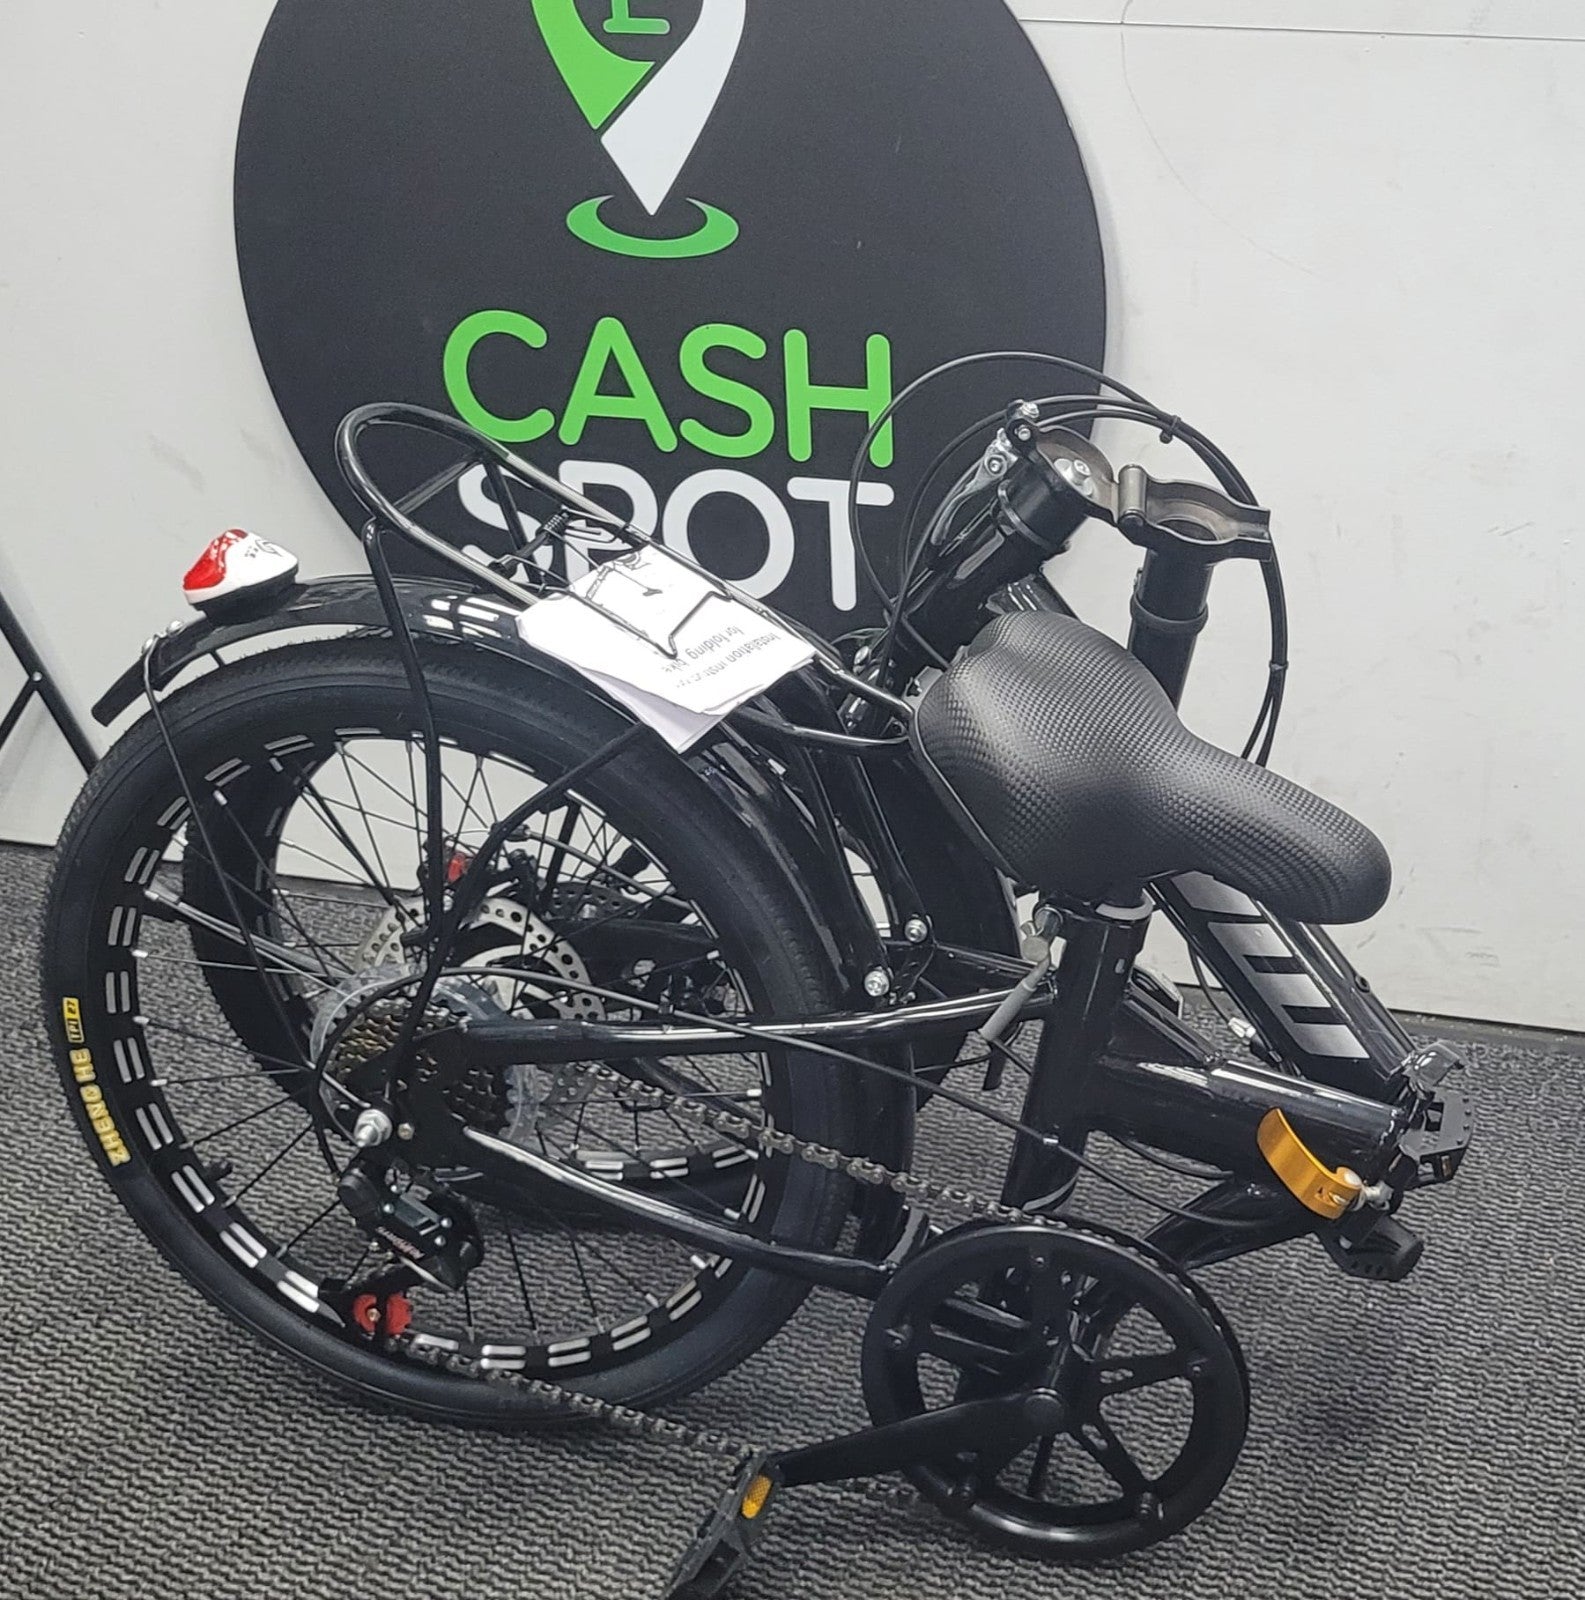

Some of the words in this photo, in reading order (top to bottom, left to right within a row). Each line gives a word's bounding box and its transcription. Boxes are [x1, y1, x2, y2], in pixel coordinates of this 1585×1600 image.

[443, 310, 894, 468] CASH
[458, 460, 895, 611] SPOT
[685, 633, 731, 660] folding
[69, 1048, 96, 1082] HE
